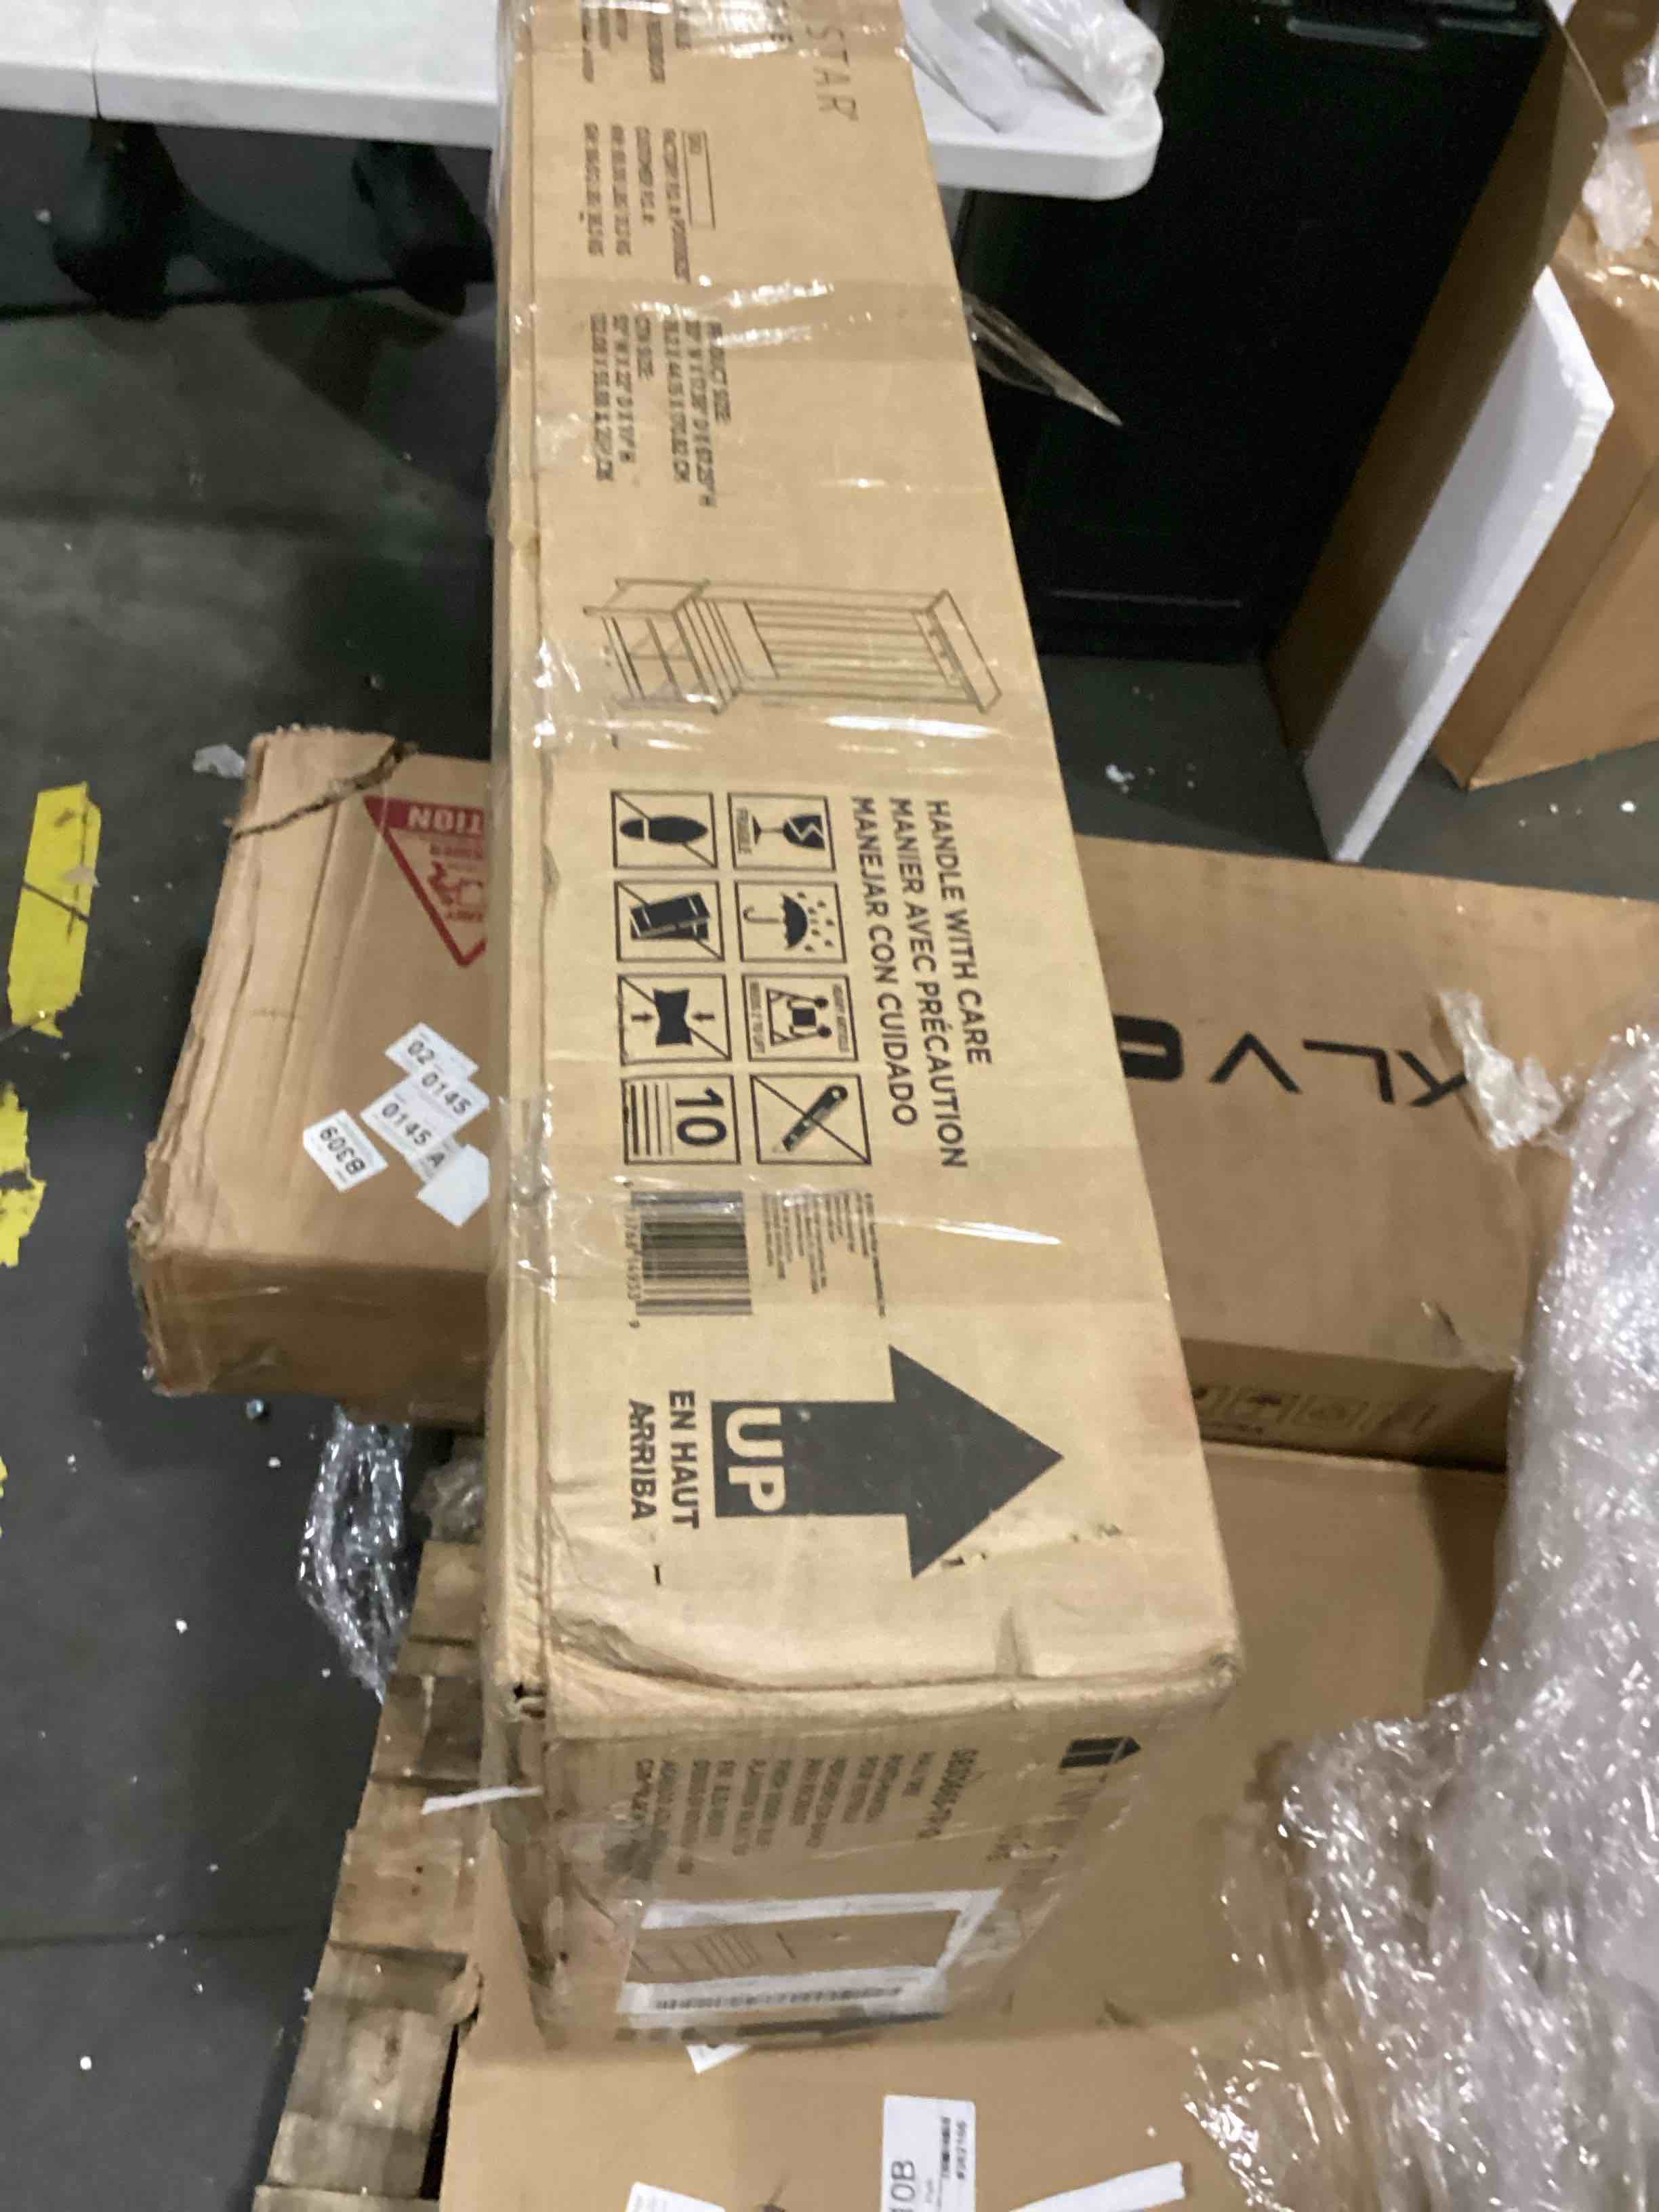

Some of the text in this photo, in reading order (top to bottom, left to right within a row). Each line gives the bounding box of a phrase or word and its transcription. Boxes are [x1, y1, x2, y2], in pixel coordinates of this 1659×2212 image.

[805, 24, 858, 122] STAR
[851, 796, 917, 1127] MANEJAR CON CUIDADO
[888, 797, 967, 1168] MANIER AVEC PRÉCAUTION
[926, 800, 991, 1065] HANDLE WITH CARE
[382, 1102, 432, 1145] 0145
[422, 1071, 472, 1115] 0145
[674, 1087, 727, 1147] 10
[628, 1399, 657, 1521] ARRIBA
[668, 1390, 699, 1530] EN HAUT
[724, 1407, 785, 1512] UP
